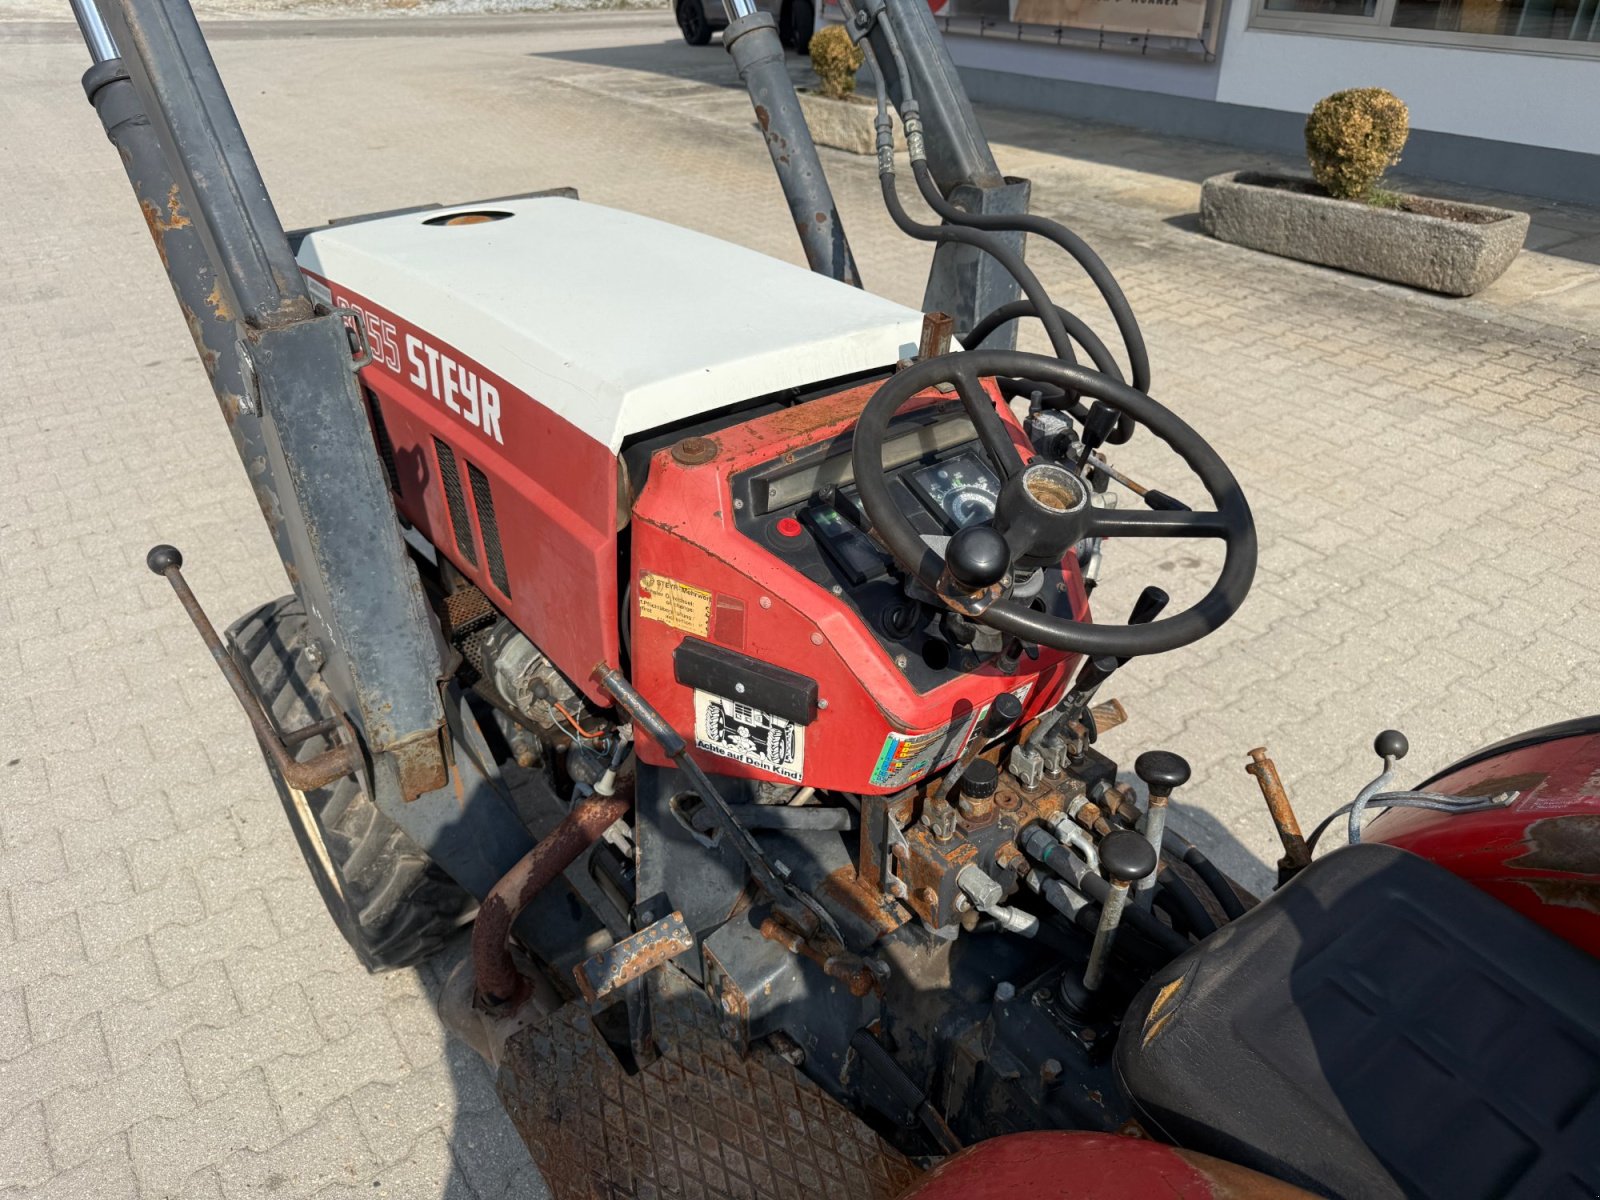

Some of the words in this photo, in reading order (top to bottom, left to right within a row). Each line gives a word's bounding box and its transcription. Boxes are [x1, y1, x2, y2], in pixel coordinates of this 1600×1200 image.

[405, 332, 504, 446] STEYR
[697, 740, 726, 755] Achte
[727, 749, 744, 763] auf
[746, 756, 771, 771] Dein
[772, 764, 803, 782] Kind!
